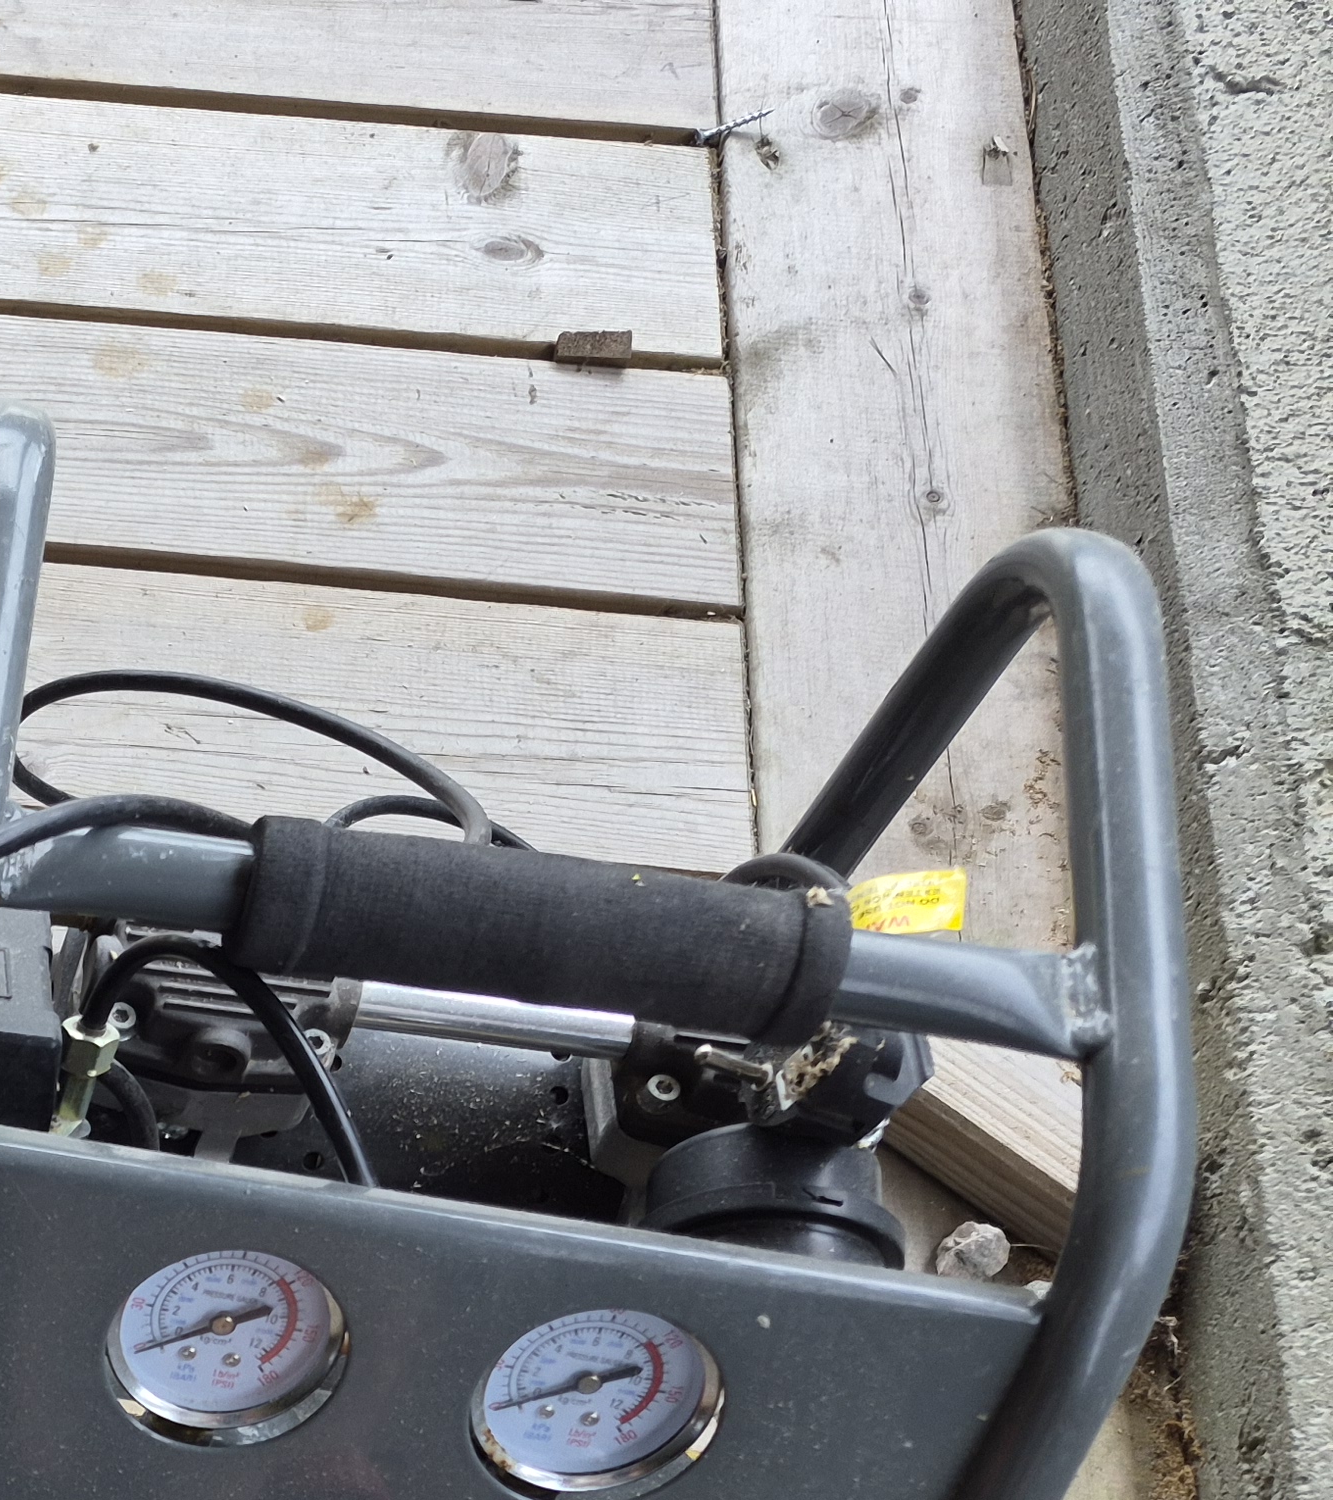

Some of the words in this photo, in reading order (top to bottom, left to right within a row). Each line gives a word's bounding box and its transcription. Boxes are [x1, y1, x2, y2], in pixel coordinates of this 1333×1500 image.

[226, 1273, 235, 1285] 6
[191, 1282, 200, 1292] 4
[258, 1286, 267, 1298] 8
[130, 1297, 146, 1311] 30
[172, 1305, 181, 1316] 2
[265, 1313, 278, 1325] 10
[302, 1324, 322, 1343] 150
[663, 1329, 684, 1349] 120
[249, 1337, 263, 1349] 12
[592, 1336, 601, 1347] 6
[257, 1370, 279, 1387] 180
[628, 1375, 642, 1386] 10
[664, 1386, 684, 1404] 150
[610, 1397, 623, 1410] 12
[615, 1429, 638, 1446] 180
